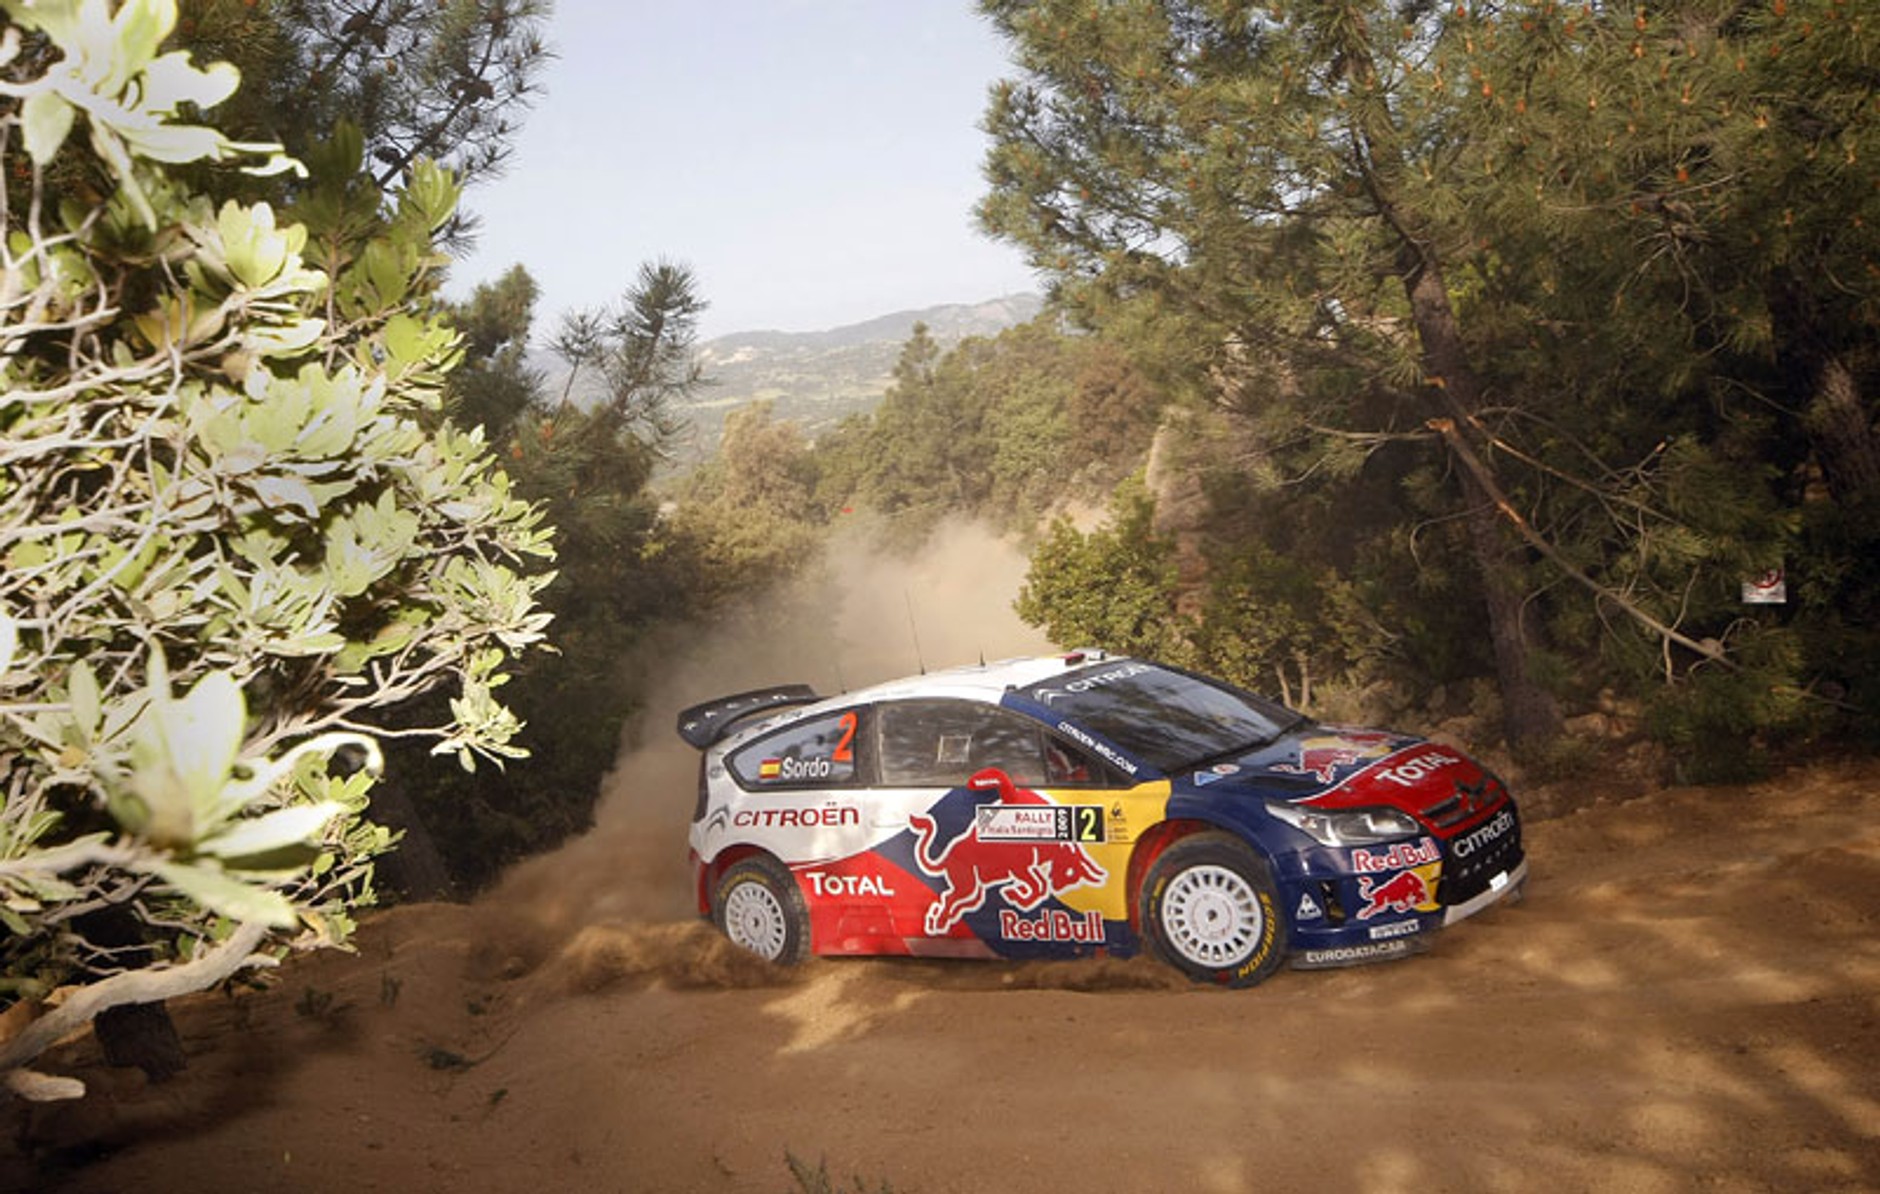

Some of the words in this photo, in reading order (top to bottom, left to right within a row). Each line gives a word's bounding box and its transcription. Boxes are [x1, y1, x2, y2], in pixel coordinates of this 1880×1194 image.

[832, 711, 857, 762] 2
[782, 757, 829, 778] Sordo
[1374, 752, 1460, 787] TOTAL
[734, 802, 859, 826] CITROËN
[1015, 812, 1052, 823] RALLY
[1080, 808, 1096, 841] 2
[1352, 844, 1401, 873] Red
[1400, 837, 1441, 868] Bull
[806, 871, 895, 896] TOTAL
[1000, 909, 1051, 941] Red
[1052, 909, 1105, 943] Bull
